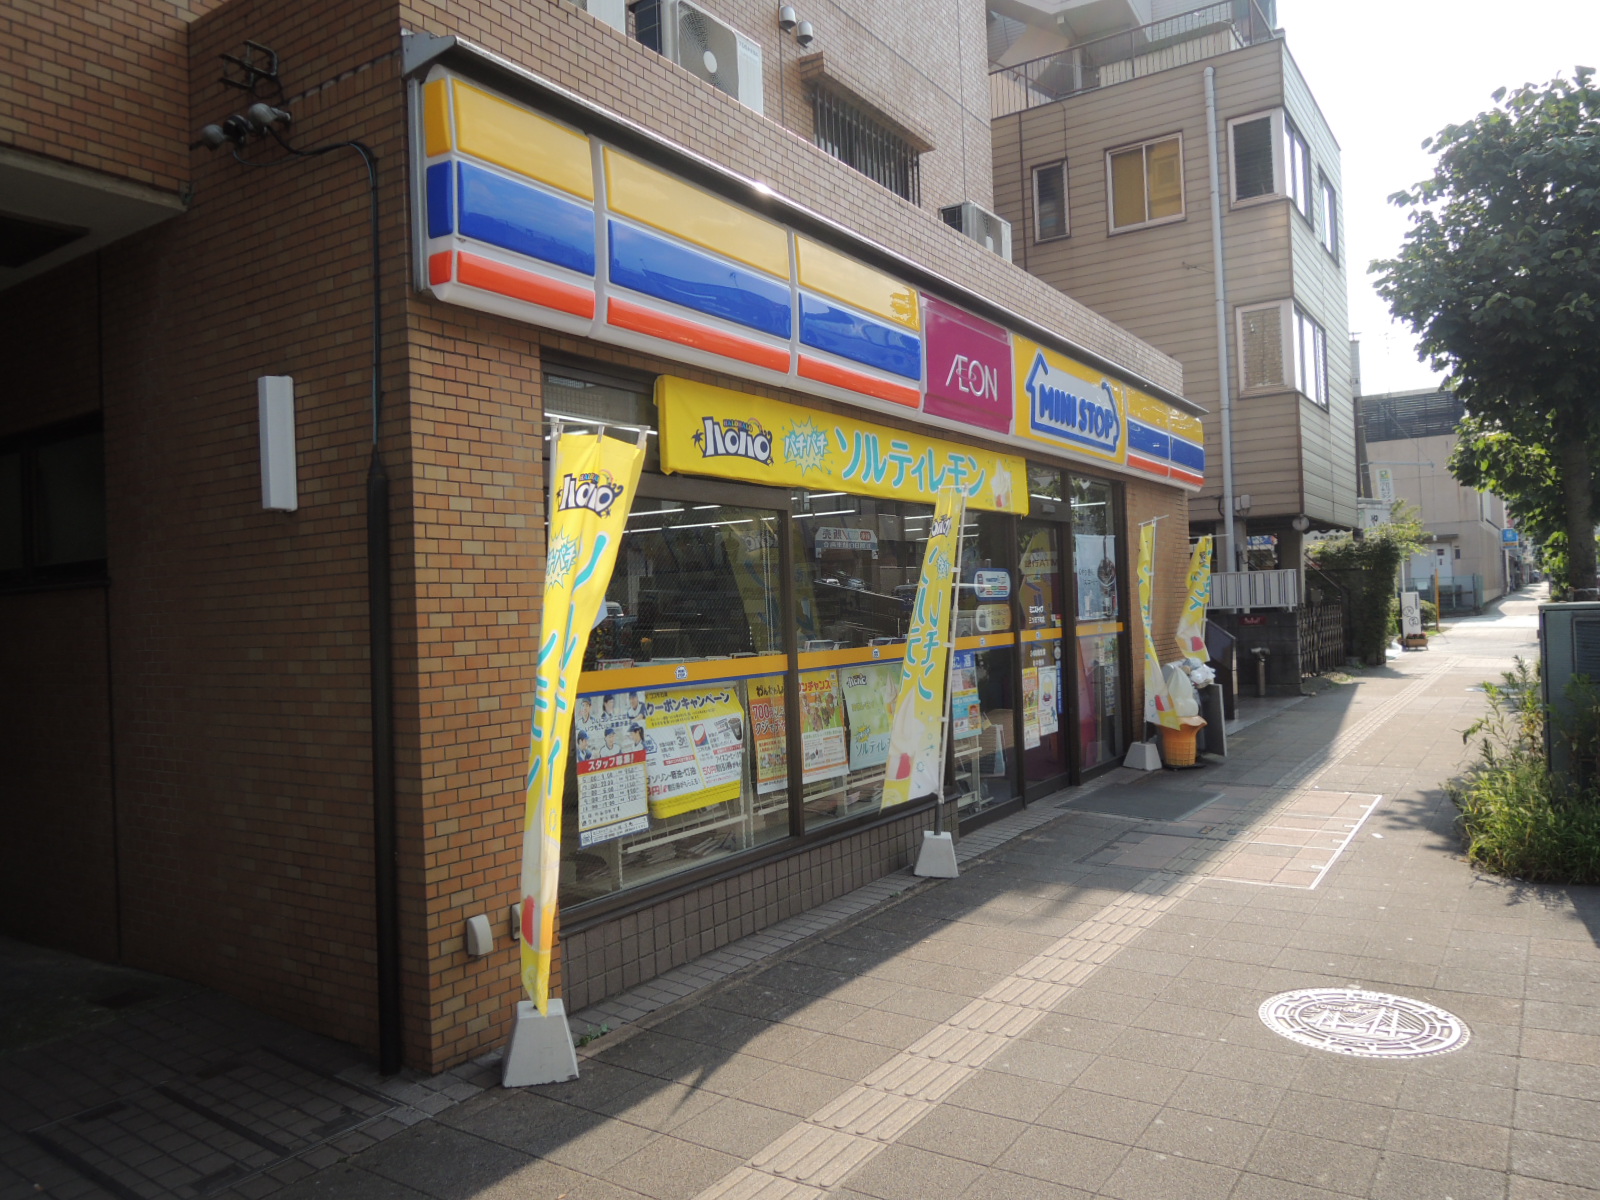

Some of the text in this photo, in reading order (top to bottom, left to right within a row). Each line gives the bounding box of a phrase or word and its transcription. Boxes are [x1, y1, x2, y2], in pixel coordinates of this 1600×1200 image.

[1039, 383, 1114, 440] MINI STOP
[784, 431, 829, 457] パチパチ
[834, 426, 986, 497] ソルティレモン
[646, 692, 730, 716] クーポンキャンペーン
